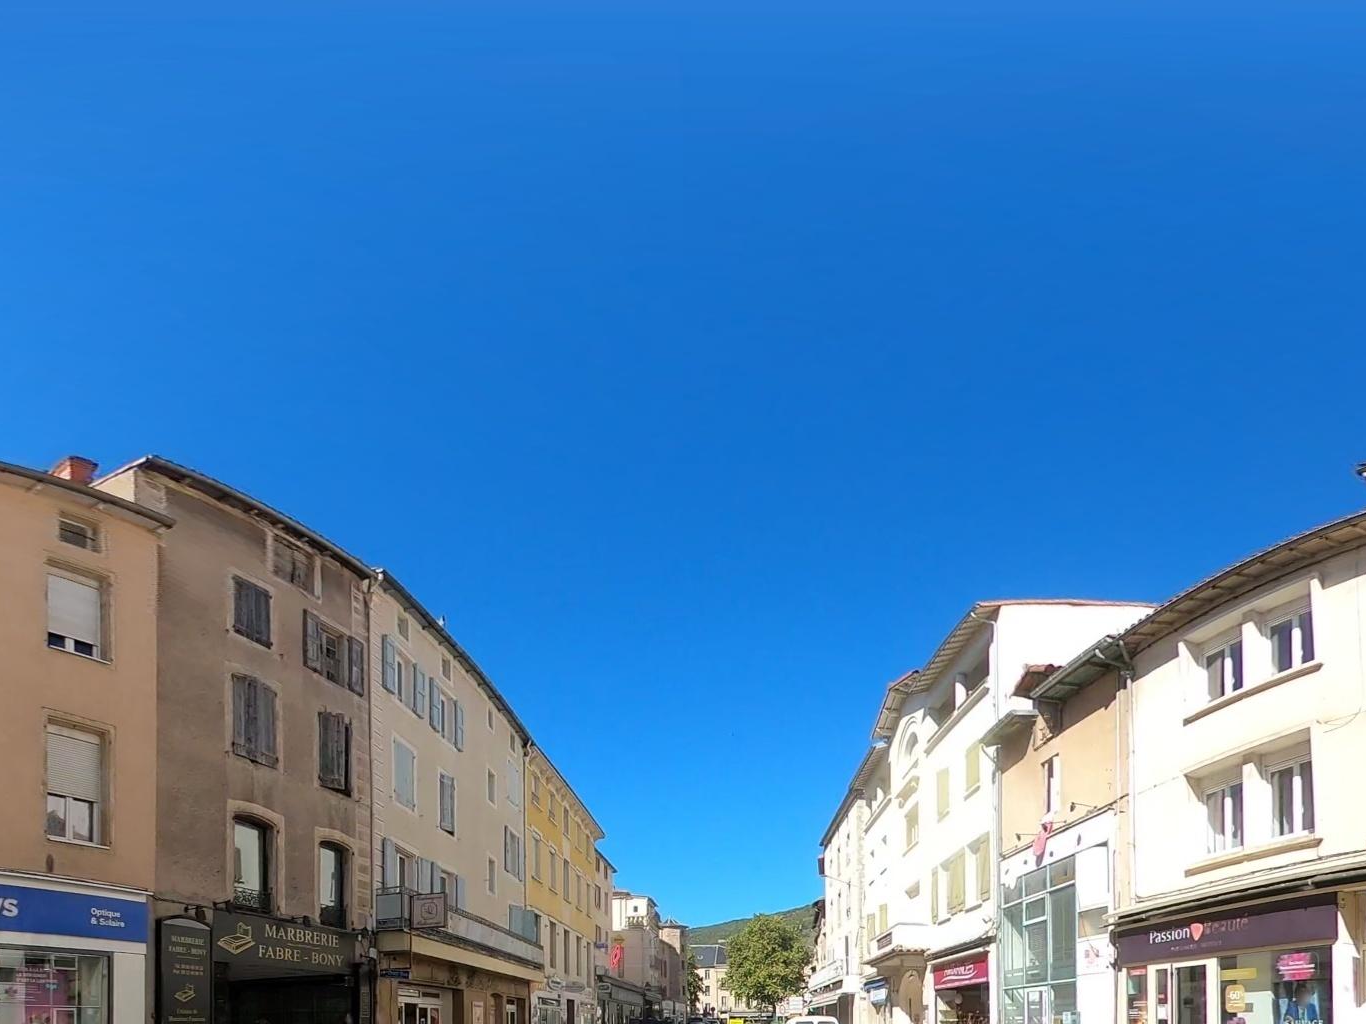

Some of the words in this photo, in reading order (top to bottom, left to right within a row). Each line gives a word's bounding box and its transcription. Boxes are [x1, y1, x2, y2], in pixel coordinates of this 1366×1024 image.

[90, 907, 121, 919] Optique
[90, 917, 98, 925] &
[99, 918, 125, 928] Solaire
[171, 935, 204, 946] MARBRERIE
[264, 923, 339, 948] MARBRERIE
[1149, 927, 1190, 945] Passion
[258, 944, 301, 962] FABRE
[311, 952, 344, 967] BONY
